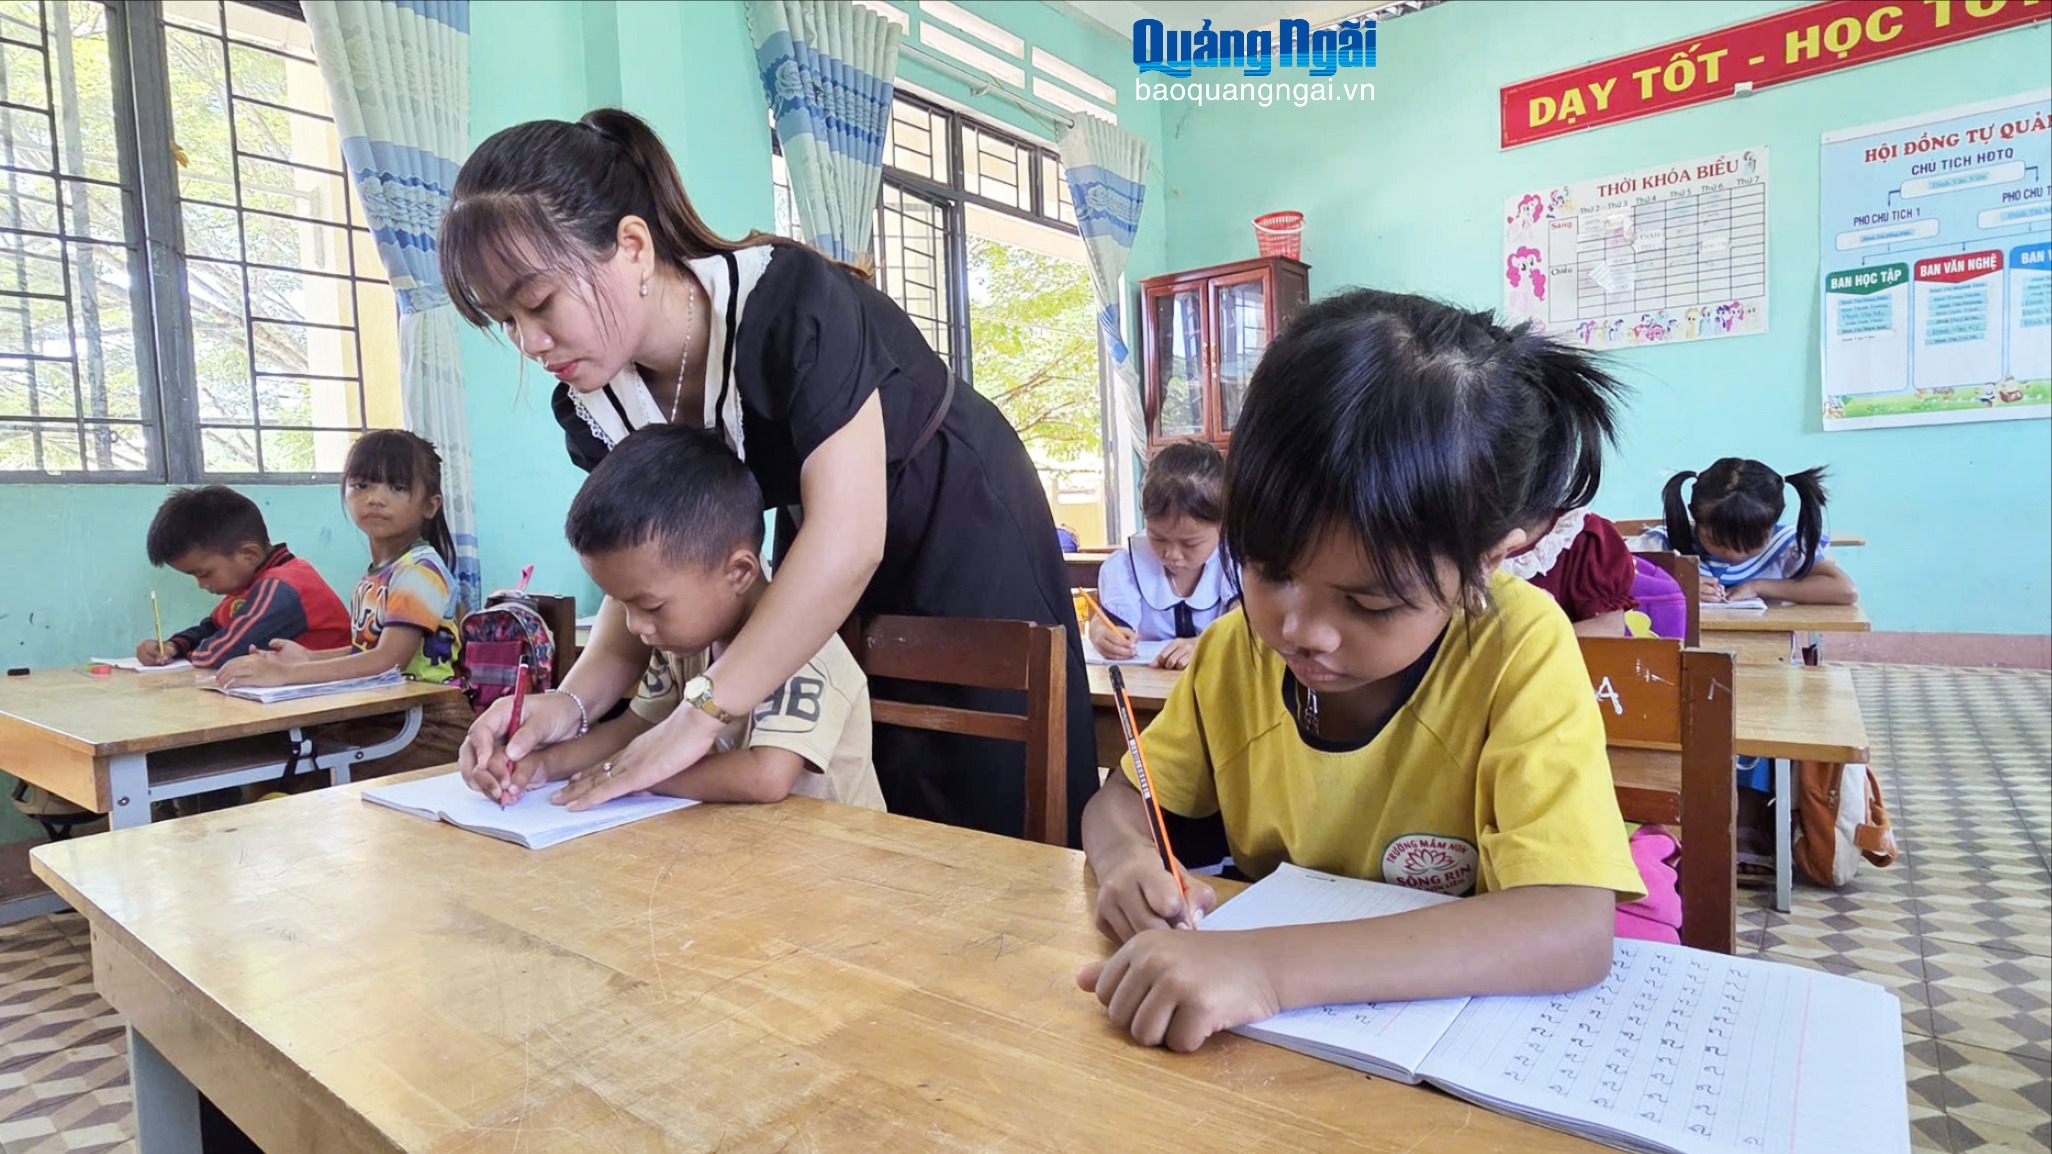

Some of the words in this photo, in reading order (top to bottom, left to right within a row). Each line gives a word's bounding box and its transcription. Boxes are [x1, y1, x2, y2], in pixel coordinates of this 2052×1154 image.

[1529, 77, 1617, 128] DẠY
[1632, 43, 1728, 100] TỐT
[1785, 6, 1903, 63] HỌC
[1864, 143, 1898, 163] HỘI
[1966, 123, 1995, 145] TỰ
[1596, 177, 1637, 198] THỜI
[1642, 167, 1692, 191] KHÓA
[1696, 155, 1739, 180] BIỂU
[1916, 207, 1921, 217] 1
[1920, 264, 1941, 277] BAN
[1944, 257, 1964, 273] VĂN
[1968, 253, 1998, 270] NGHỆ
[2021, 250, 2045, 264] BAN
[1831, 276, 1852, 290] BAN
[1855, 272, 1878, 288] HỌC
[1880, 266, 1902, 284] TẬP
[1444, 864, 1472, 880] RIN
